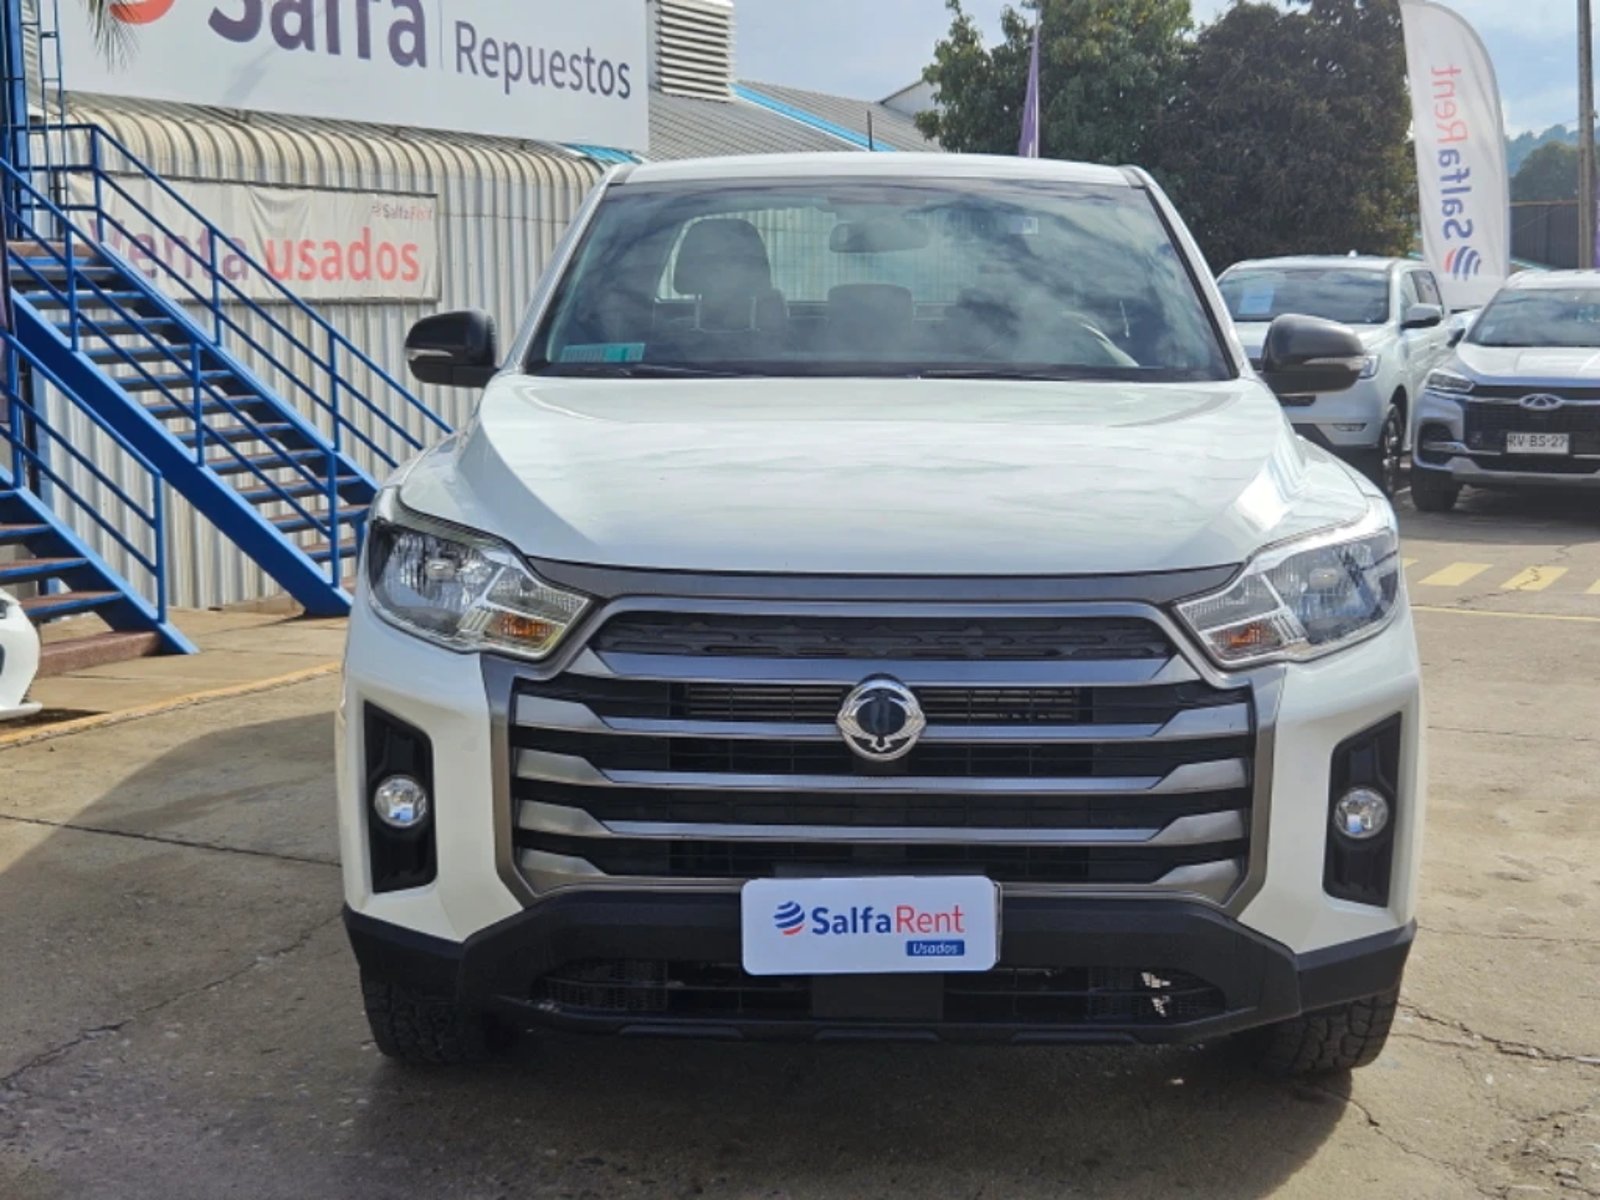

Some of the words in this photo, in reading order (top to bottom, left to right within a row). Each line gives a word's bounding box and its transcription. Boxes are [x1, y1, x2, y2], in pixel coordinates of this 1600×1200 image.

[455, 20, 631, 100] Repuestos
[265, 226, 420, 282] usados
[811, 905, 965, 935] SalfaRent
[913, 943, 958, 954] Usados
